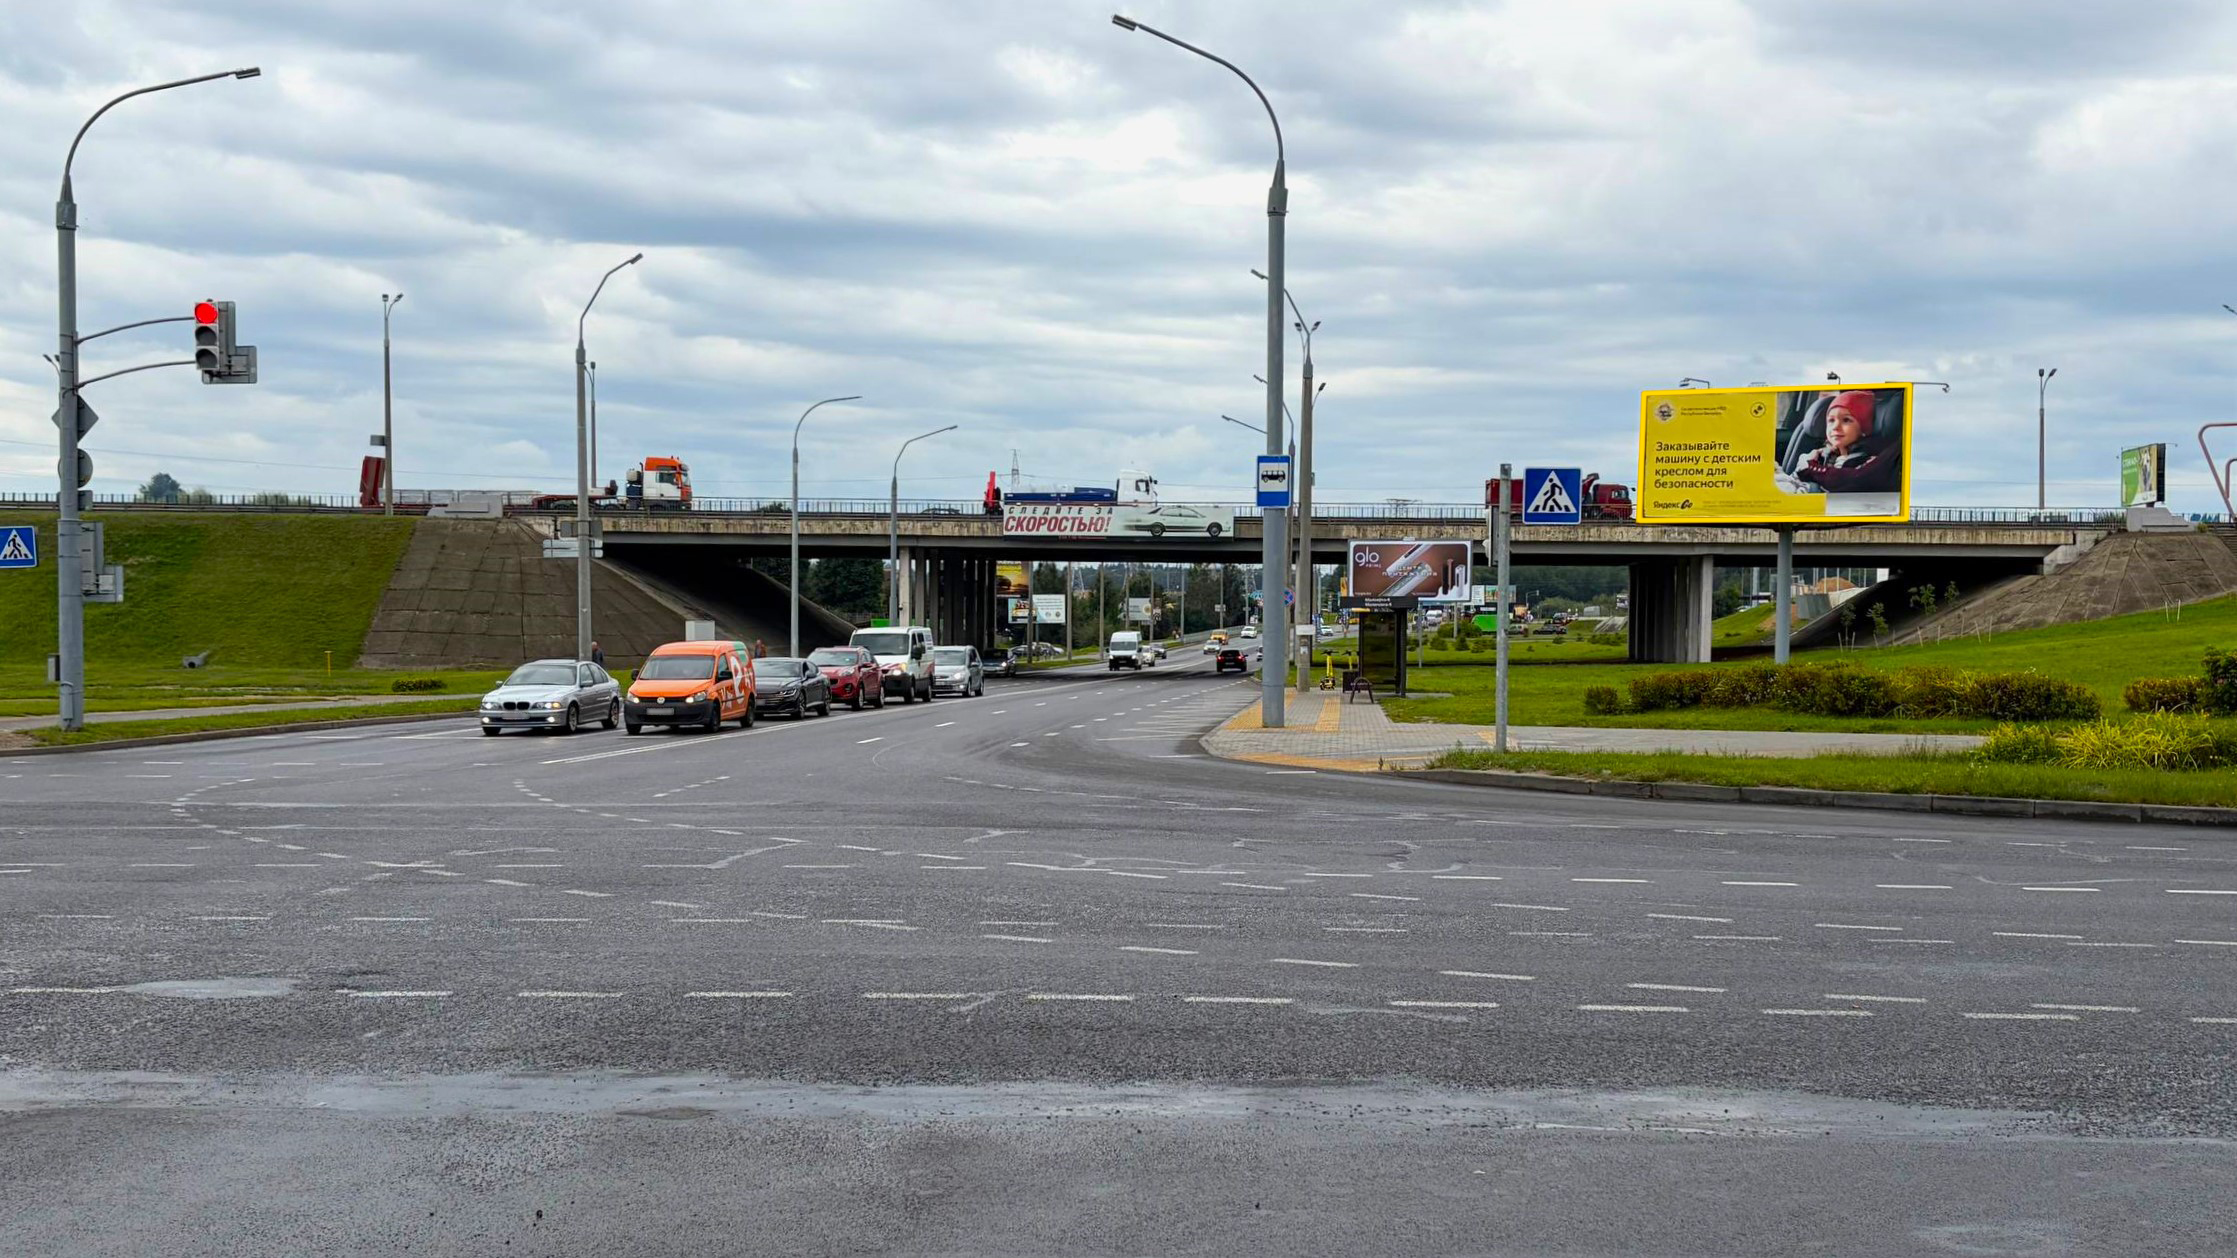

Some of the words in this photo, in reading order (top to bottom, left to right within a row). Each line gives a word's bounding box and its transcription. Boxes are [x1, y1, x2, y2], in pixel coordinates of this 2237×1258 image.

[1656, 441, 1730, 452] Заказывайте
[1655, 456, 1701, 465] машину
[1703, 455, 1710, 463] с
[1711, 455, 1761, 464] детским
[1655, 468, 1704, 477] креслом
[1706, 467, 1727, 477] для
[1654, 479, 1734, 489] безопасности
[1653, 500, 1680, 509] Яндекс
[1680, 499, 1693, 510] Go
[1008, 506, 1084, 515] СЛЕДИТЕ
[1096, 507, 1113, 515] ЗА
[1004, 516, 1112, 532] СКОРОСТЬЮ!
[1355, 546, 1380, 567] glo
